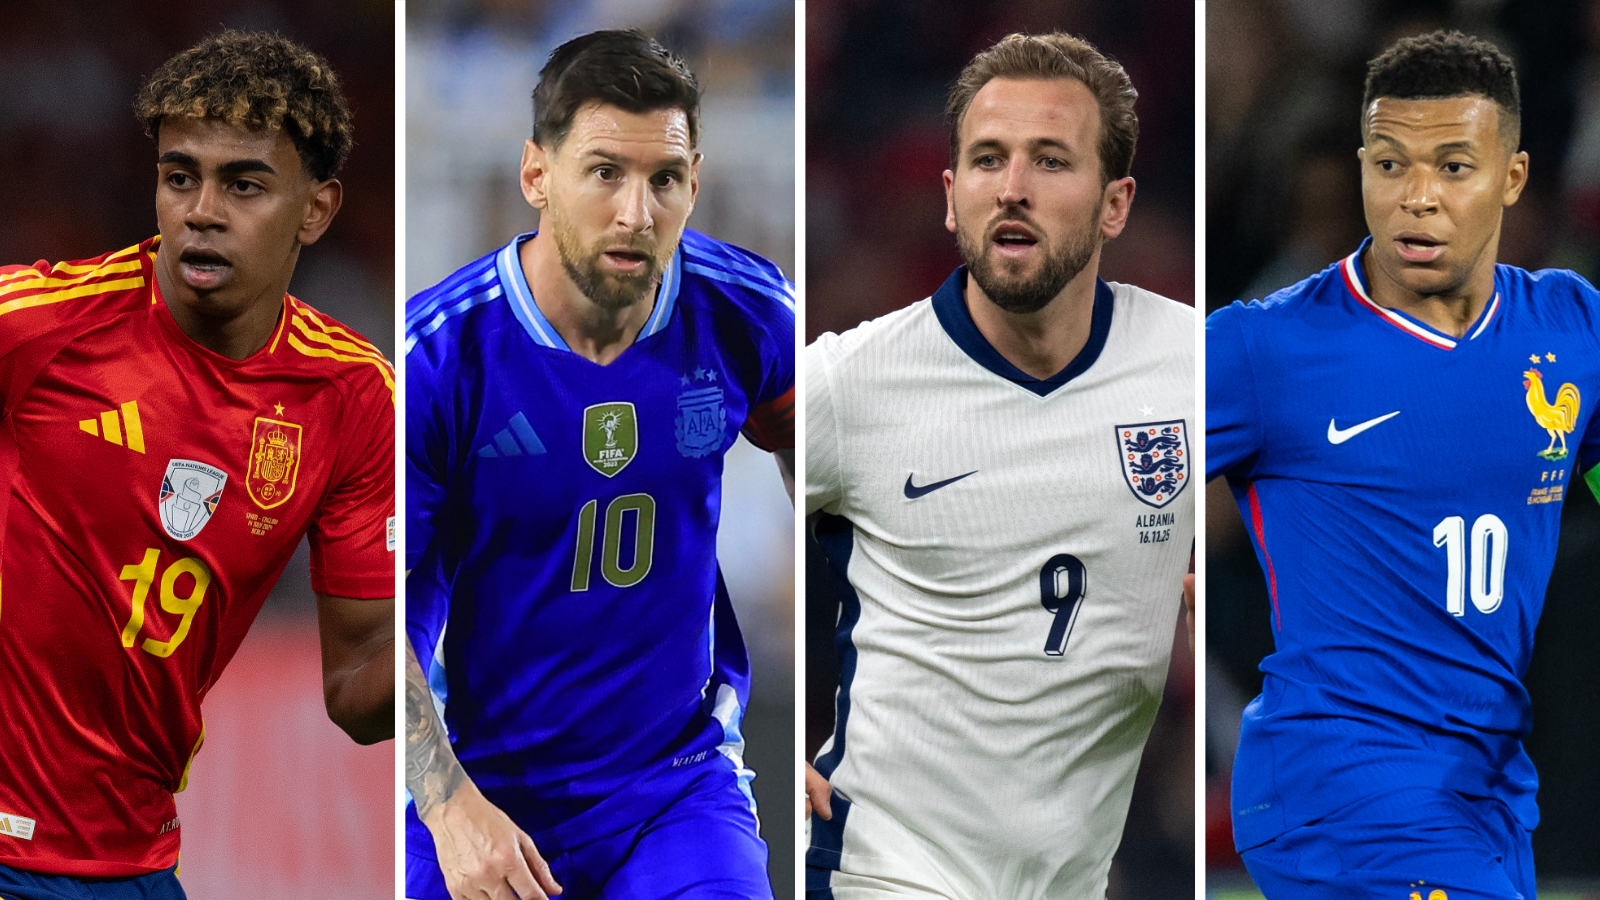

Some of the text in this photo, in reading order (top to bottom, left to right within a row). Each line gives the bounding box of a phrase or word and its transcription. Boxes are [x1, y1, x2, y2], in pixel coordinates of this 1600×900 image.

[687, 406, 716, 437] AFA
[599, 448, 623, 459] FIFA
[185, 462, 207, 471] NATIONS
[206, 467, 225, 480] LEAGUE
[166, 525, 183, 538] WINNER
[1135, 512, 1175, 528] ALBANIA
[570, 492, 656, 592] 10
[1139, 529, 1171, 544] 16.11.25
[1432, 513, 1509, 618] 10
[119, 547, 212, 658] 19
[1039, 553, 1087, 657] 9
